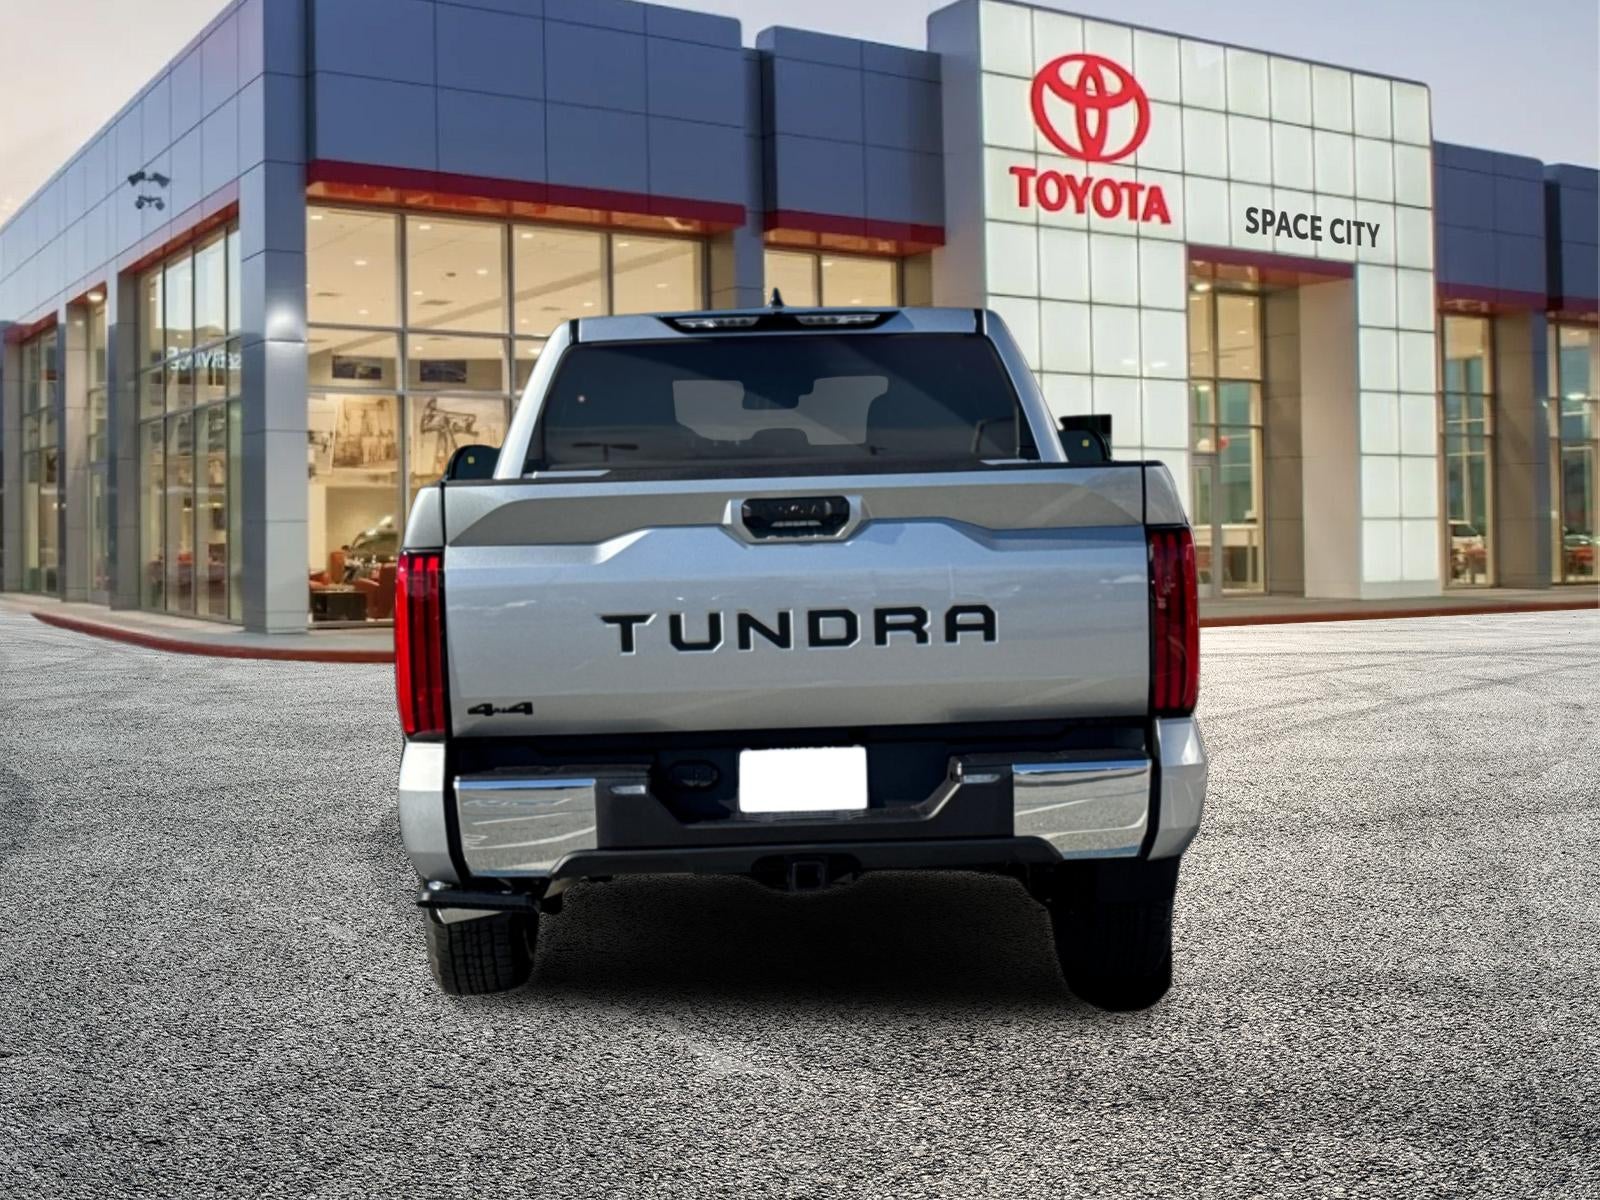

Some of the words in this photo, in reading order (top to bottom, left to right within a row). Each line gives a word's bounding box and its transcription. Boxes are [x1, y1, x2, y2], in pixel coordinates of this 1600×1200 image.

[1009, 166, 1171, 224] TOYOTA
[1246, 206, 1322, 241] SPACE
[1329, 217, 1381, 247] CITY
[598, 604, 999, 655] TUNDRA
